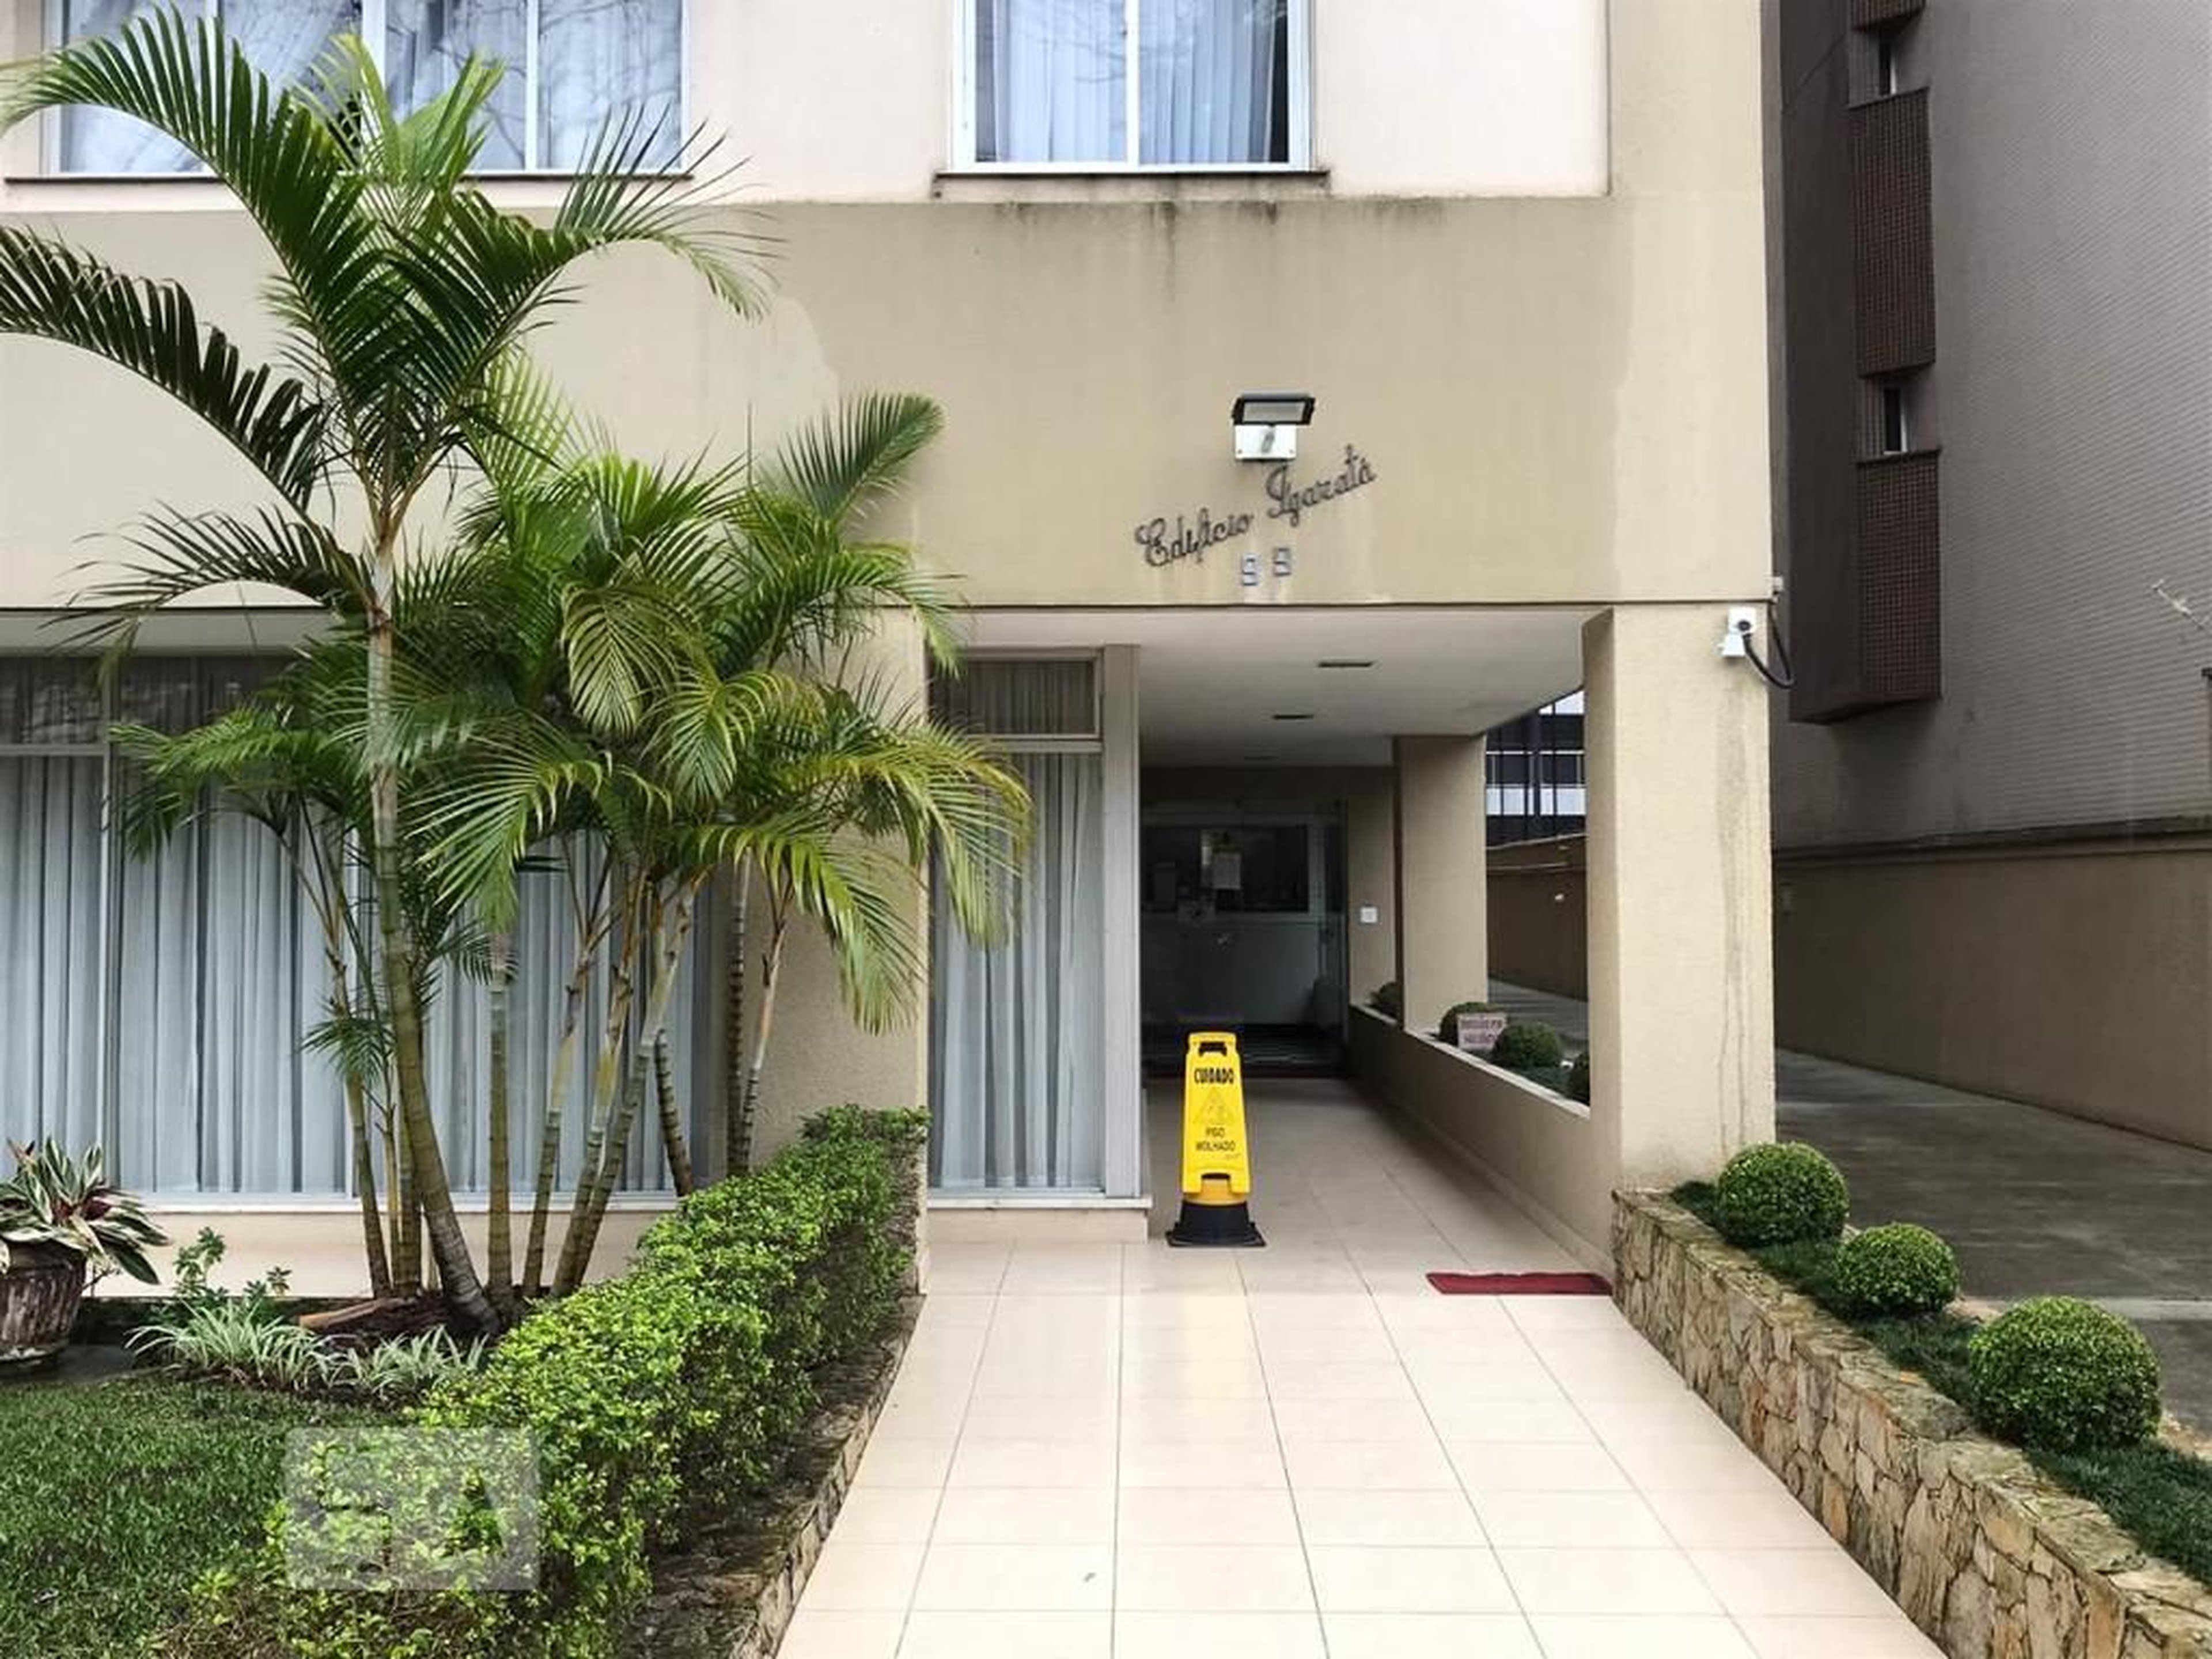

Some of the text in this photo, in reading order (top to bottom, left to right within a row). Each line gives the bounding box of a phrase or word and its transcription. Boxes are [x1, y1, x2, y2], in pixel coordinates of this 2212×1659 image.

[1194, 1067, 1234, 1084] CUIDADO
[1206, 1127, 1225, 1138] PISO
[1196, 1140, 1236, 1152] MOLHADO
